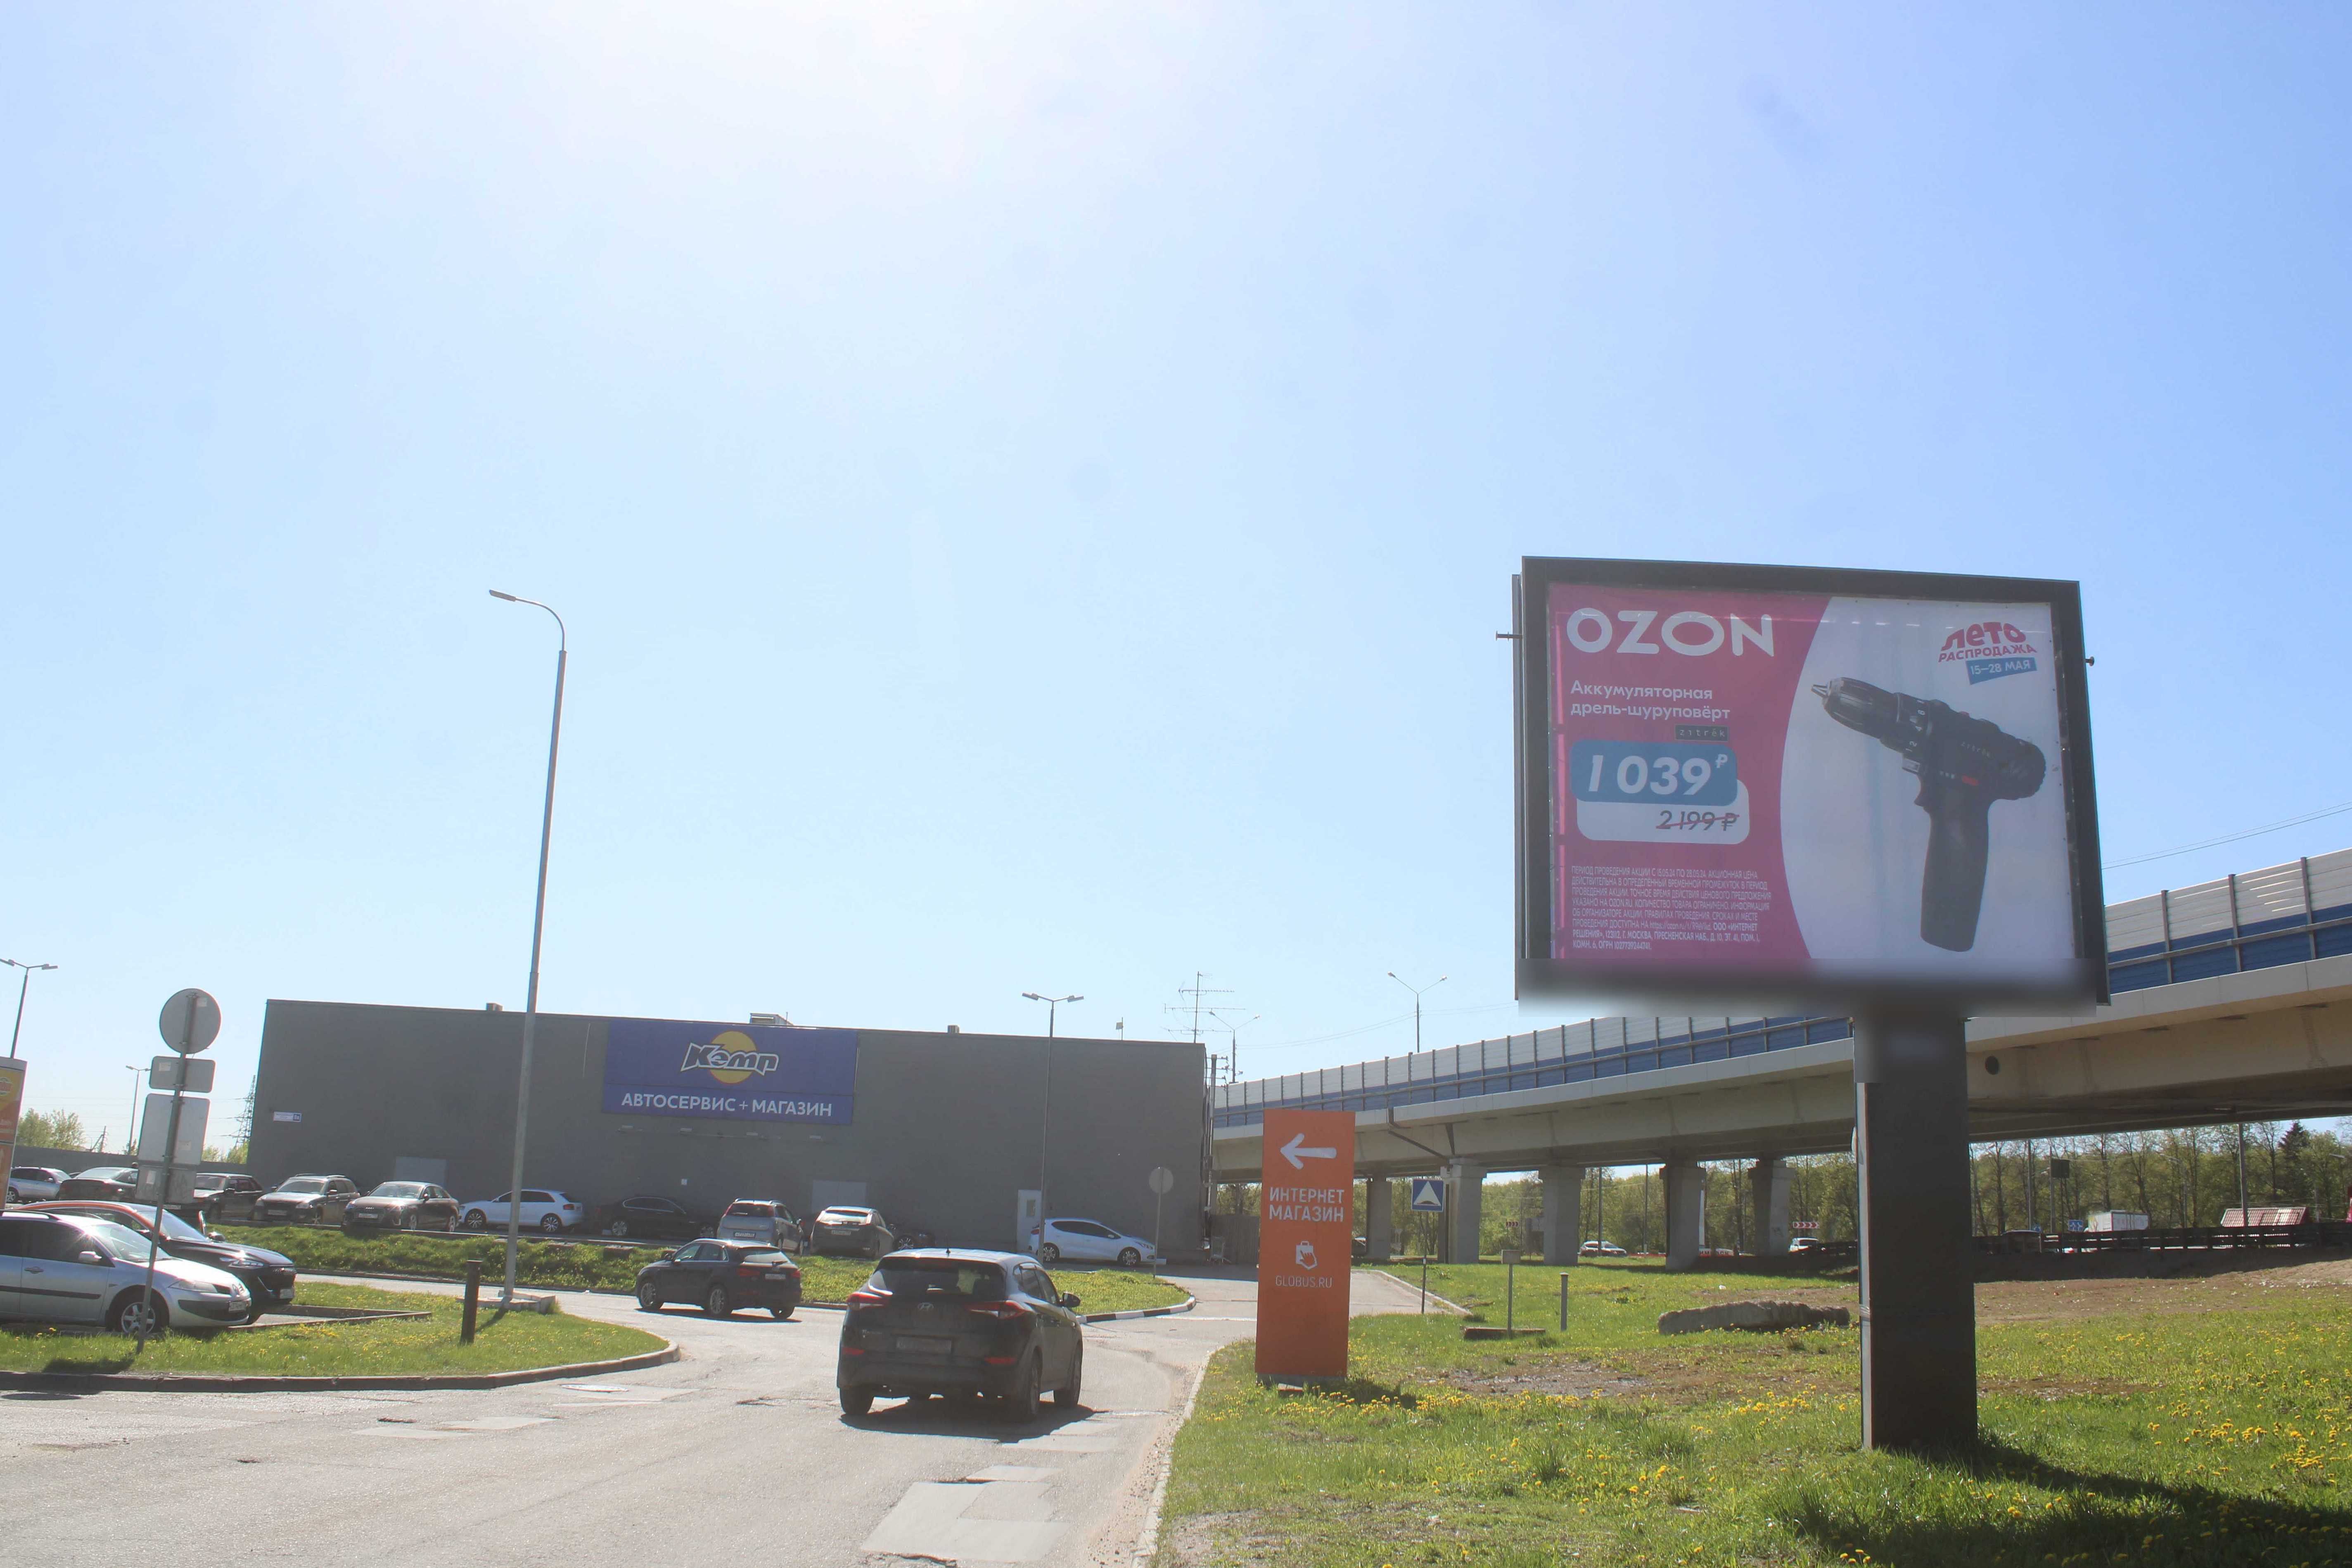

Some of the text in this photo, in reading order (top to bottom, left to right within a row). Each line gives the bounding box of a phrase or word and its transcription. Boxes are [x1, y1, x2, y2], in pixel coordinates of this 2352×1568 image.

[1567, 607, 1774, 657] OZON
[1938, 644, 2037, 662] РАСПРОДАЖА
[2005, 659, 2031, 671] МАЯ
[1570, 680, 1712, 701] Аккумуляторная
[1571, 703, 1730, 721] дрель-шуруповёрт
[1571, 866, 1593, 875] ПЕРИОД
[1594, 866, 1630, 875] ПРОВЕДЕНИЯ
[1631, 867, 1650, 876] АКЦИИ
[1676, 868, 1685, 877] ПО
[1707, 869, 1743, 878] АКЦИОННАЯ
[1743, 870, 1758, 879] ЦЕНА
[1572, 876, 1617, 886] ДЕЙСТВИТЕЛЬНА
[1667, 879, 1701, 888] ВРЕМЕННОЙ
[1702, 880, 1740, 889] ПРОМЕЖУТОК
[1745, 881, 1768, 890] ПЕРИОД
[1572, 887, 1608, 896] ПРОВЕДЕНИЯ
[1630, 888, 1652, 897] ТОЧНОЕ
[1653, 889, 1671, 897] ВРЕМЯ
[1671, 890, 1700, 898] ДЕЙСТВИЯ
[1700, 890, 1730, 899] ЦЕНОВОГО
[1731, 891, 1771, 900] ПРЕДЛОЖЕНИЯ
[1572, 897, 1598, 906] УКАЗАНО
[1599, 897, 1608, 906] НА
[1634, 898, 1671, 907] КОЛИЧЕСТВО
[1672, 899, 1692, 908] ТОВАРА
[1572, 908, 1581, 916] ОБ
[1581, 908, 1622, 917] ОРГАНИЗАТОРЕ
[1644, 910, 1674, 919] ПРАВИЛАХ
[1712, 911, 1734, 920] СРОКАХ
[1740, 912, 1758, 921] МЕСТЕ
[1572, 918, 1608, 927] ПРОВЕДЕНИЯ
[1609, 919, 1640, 928] ДОСТУПНА
[1640, 920, 1648, 928] НА
[1713, 922, 1727, 930] ООО
[1653, 930, 1694, 940] ПРЕСНЕНСКАЯ
[1598, 939, 1613, 948] ОГРН
[621, 1092, 832, 1117] АВТОСЕРВИС + МАГАЗИН
[1269, 1187, 1344, 1204] ИНТЕРНЕТ
[1269, 1205, 1344, 1222] МАГАЗИН
[1275, 1275, 1332, 1288] GLOBUS.RU
